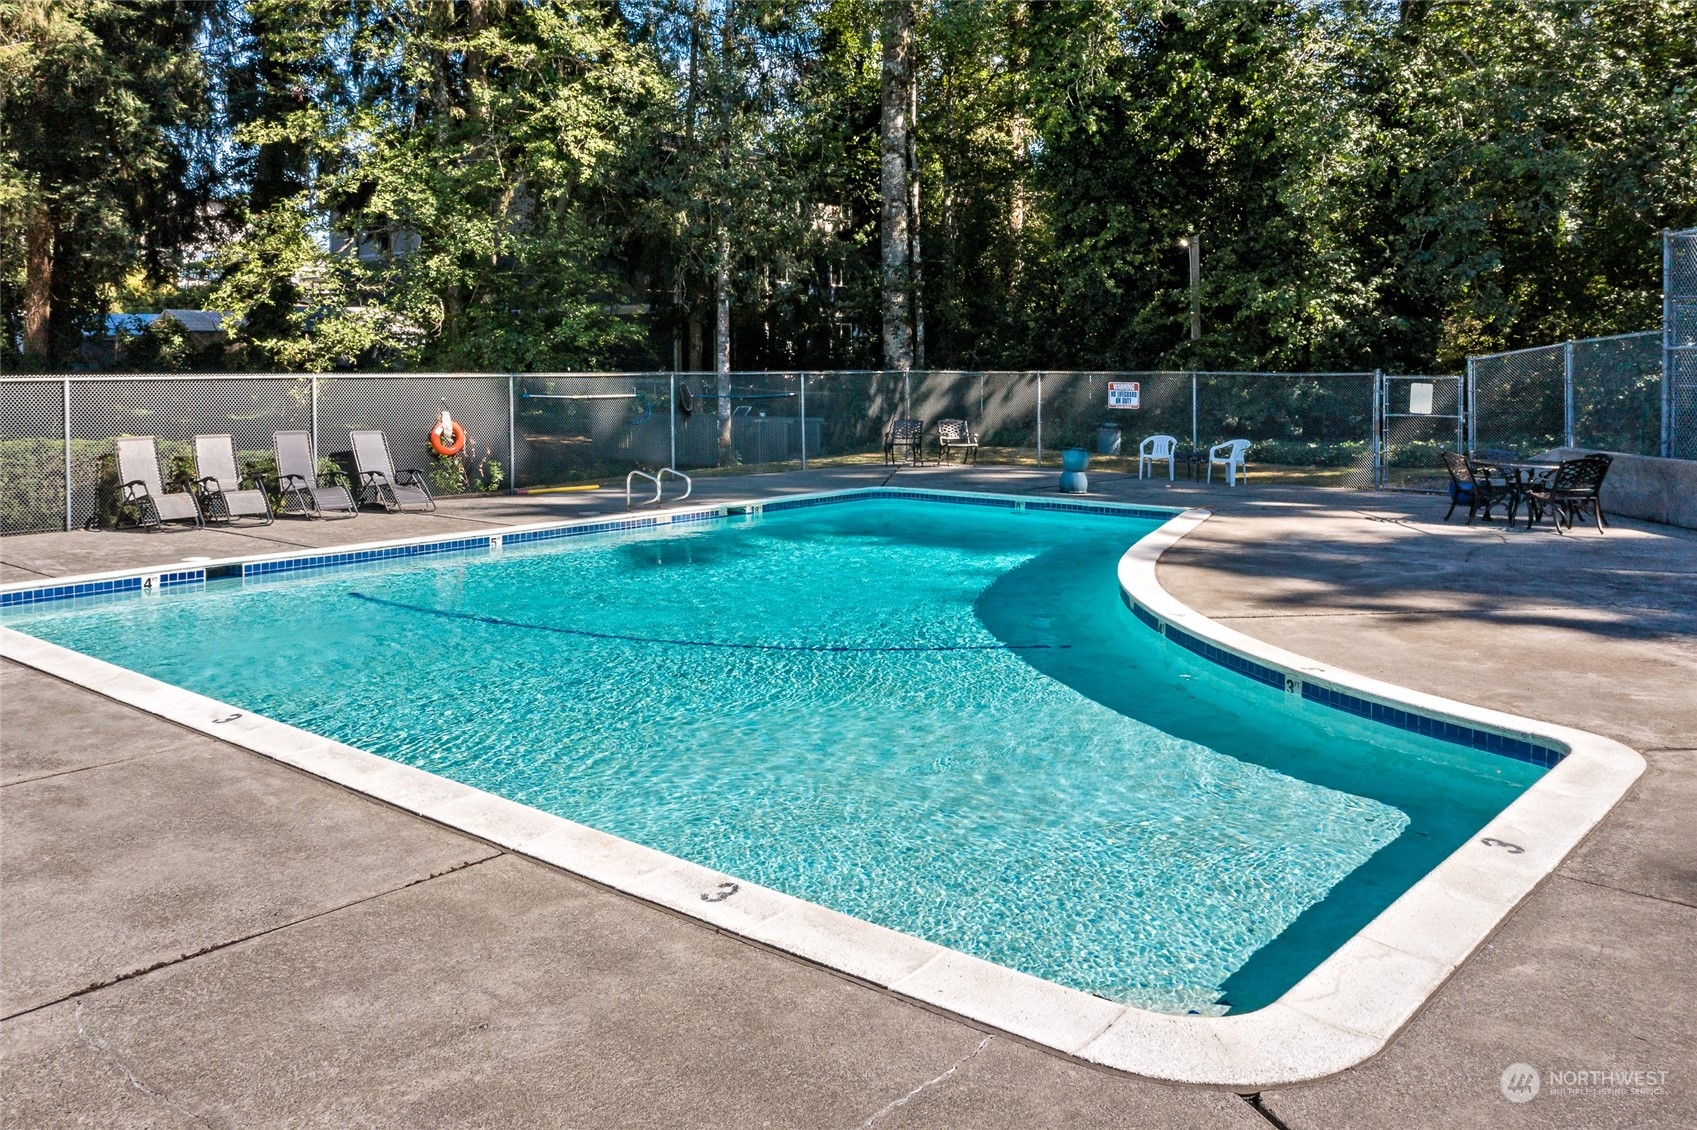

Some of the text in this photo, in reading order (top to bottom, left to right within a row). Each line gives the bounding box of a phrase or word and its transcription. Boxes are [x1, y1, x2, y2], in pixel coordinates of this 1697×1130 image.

[143, 577, 152, 588] 4
[1286, 679, 1294, 694] 3
[211, 713, 243, 724] 3
[1481, 837, 1525, 854] 3
[700, 882, 739, 903] 3
